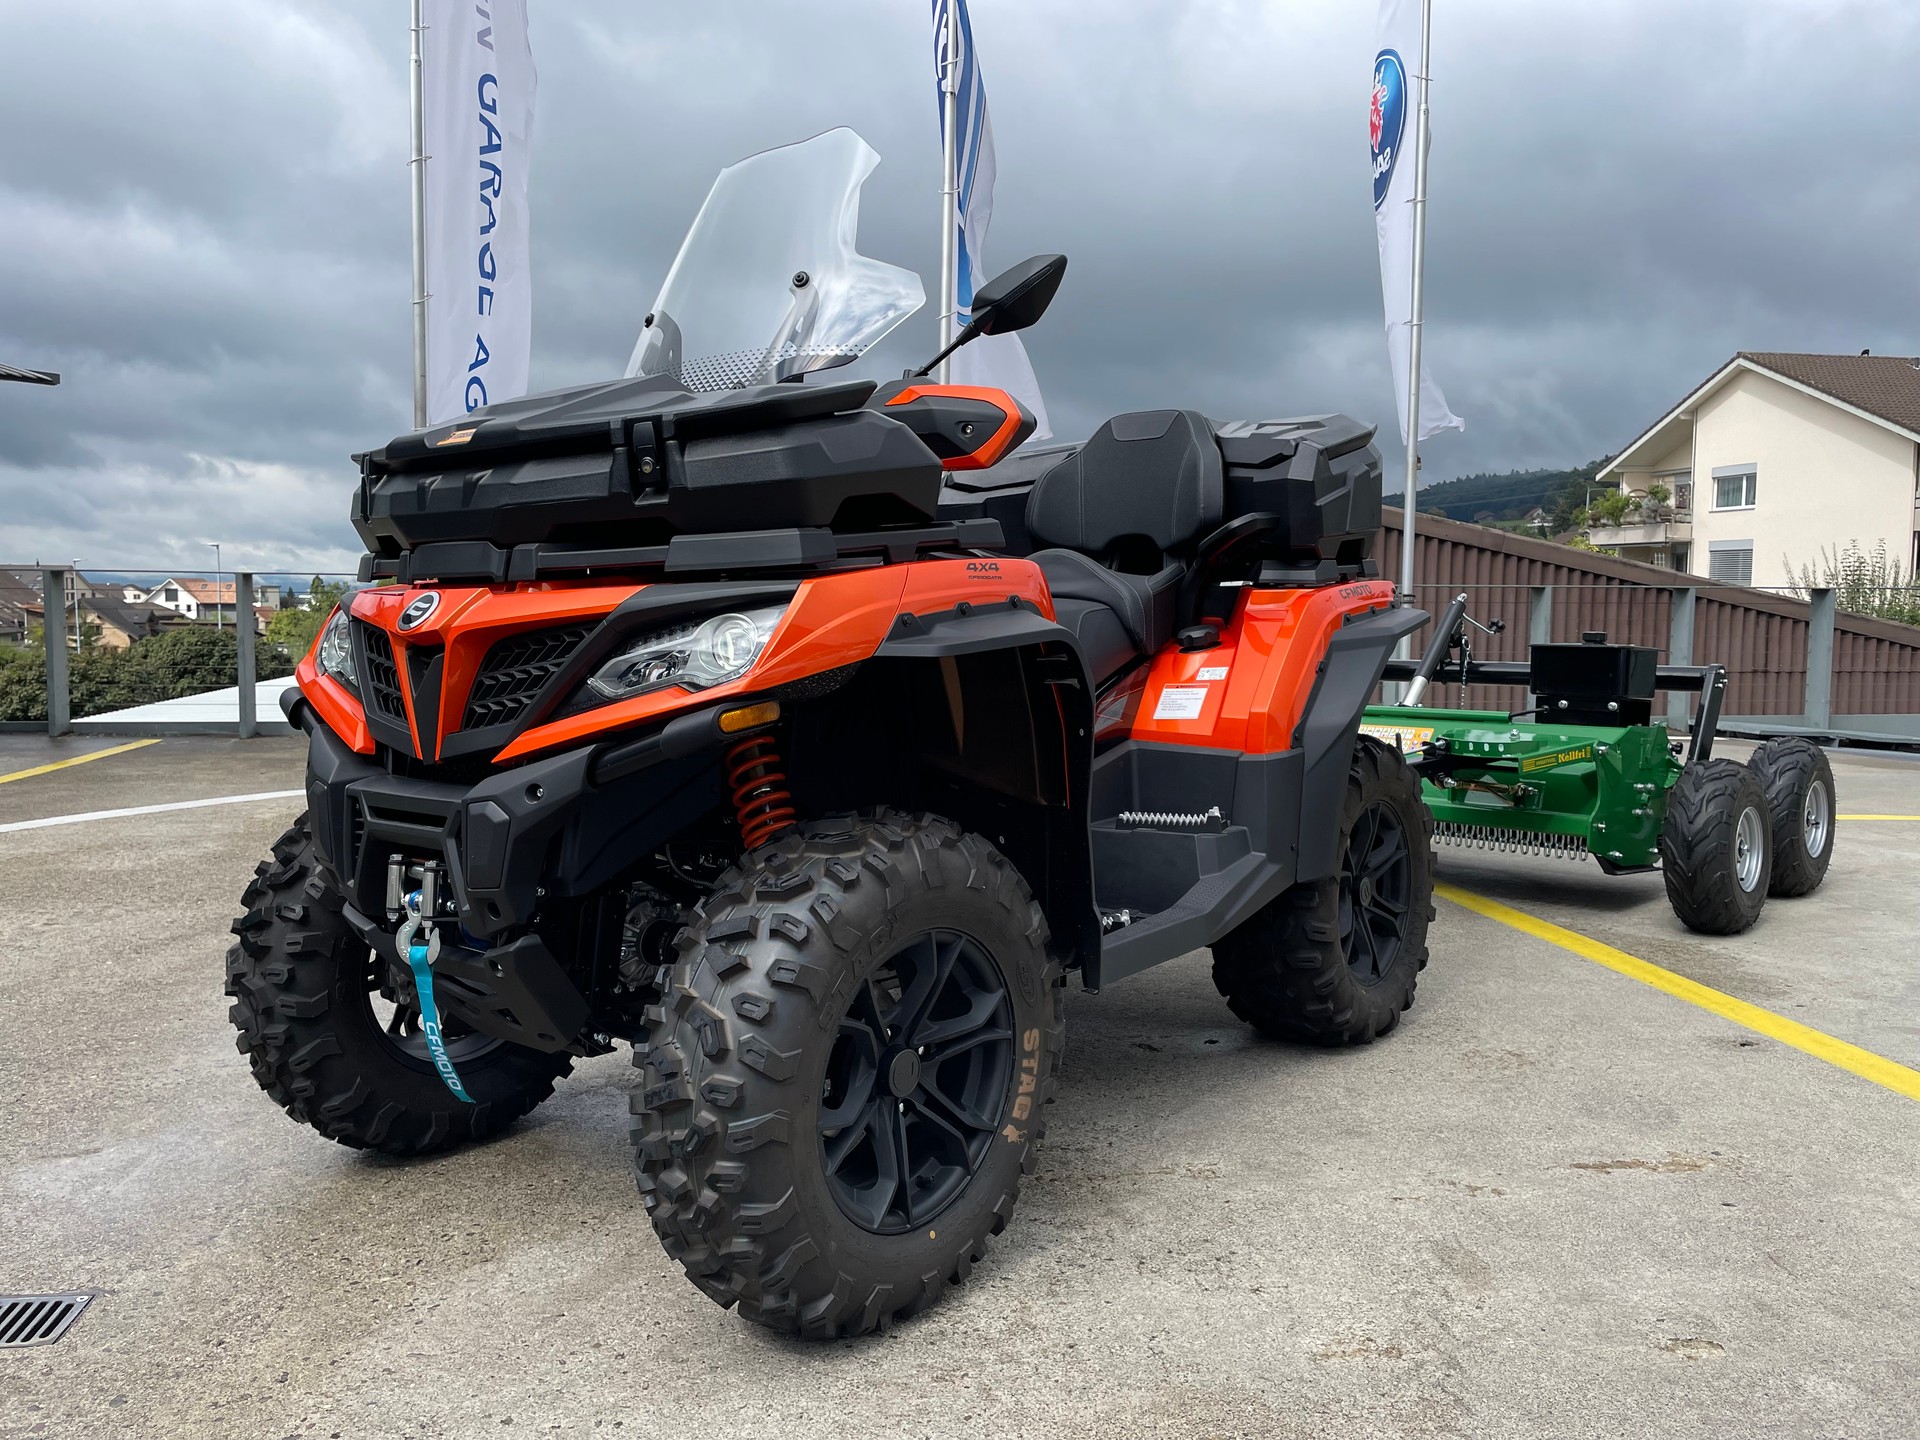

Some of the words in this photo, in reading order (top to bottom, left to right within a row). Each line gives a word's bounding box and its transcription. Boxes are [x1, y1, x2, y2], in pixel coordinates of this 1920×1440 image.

[465, 333, 490, 413] AG
[1339, 584, 1373, 599] CFMOTO
[1558, 748, 1585, 763] Kellfri
[425, 1021, 462, 1091] CFMOTO
[1011, 1028, 1040, 1121] STAG
